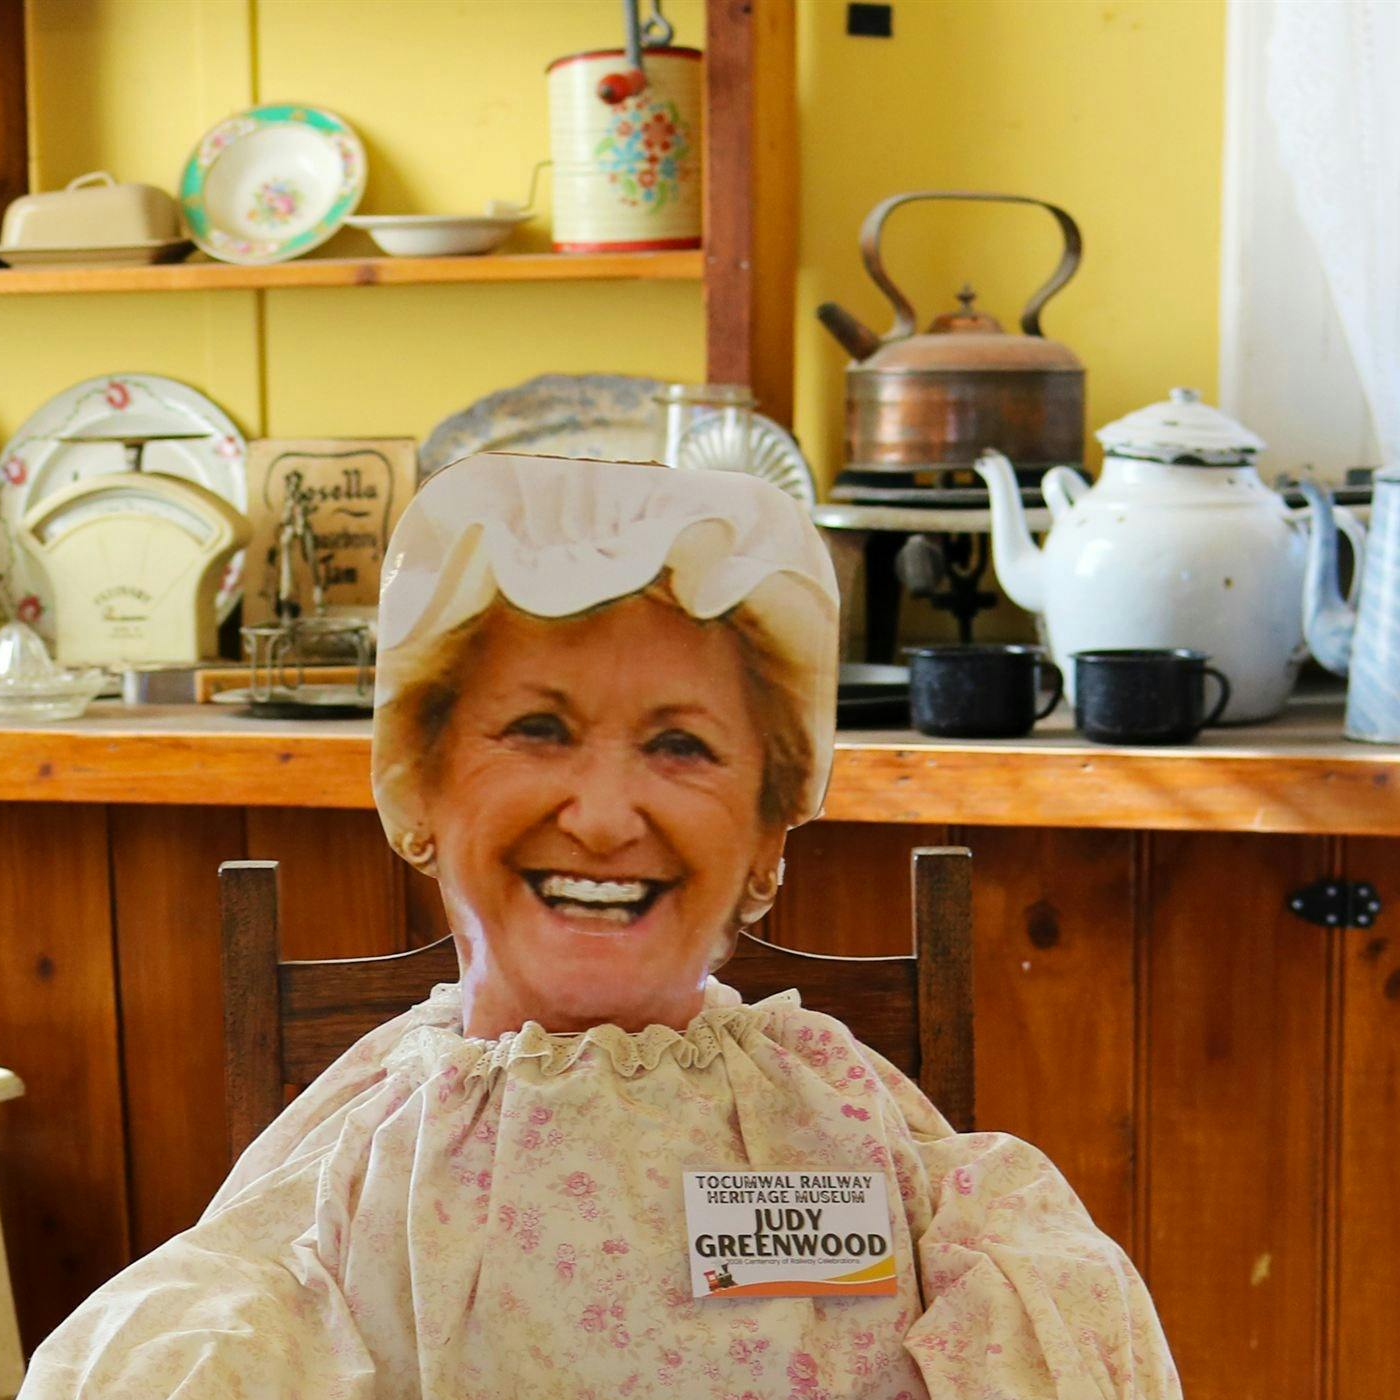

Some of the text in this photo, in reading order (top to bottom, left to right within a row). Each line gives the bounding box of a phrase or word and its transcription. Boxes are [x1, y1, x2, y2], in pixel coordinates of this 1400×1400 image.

[695, 1174, 873, 1190] TOCUMWAL RAILWAY
[707, 1190, 865, 1204] HERITAGE MUSEUM
[753, 1207, 823, 1233] JUDY
[694, 1232, 888, 1258] GREENWOOD
